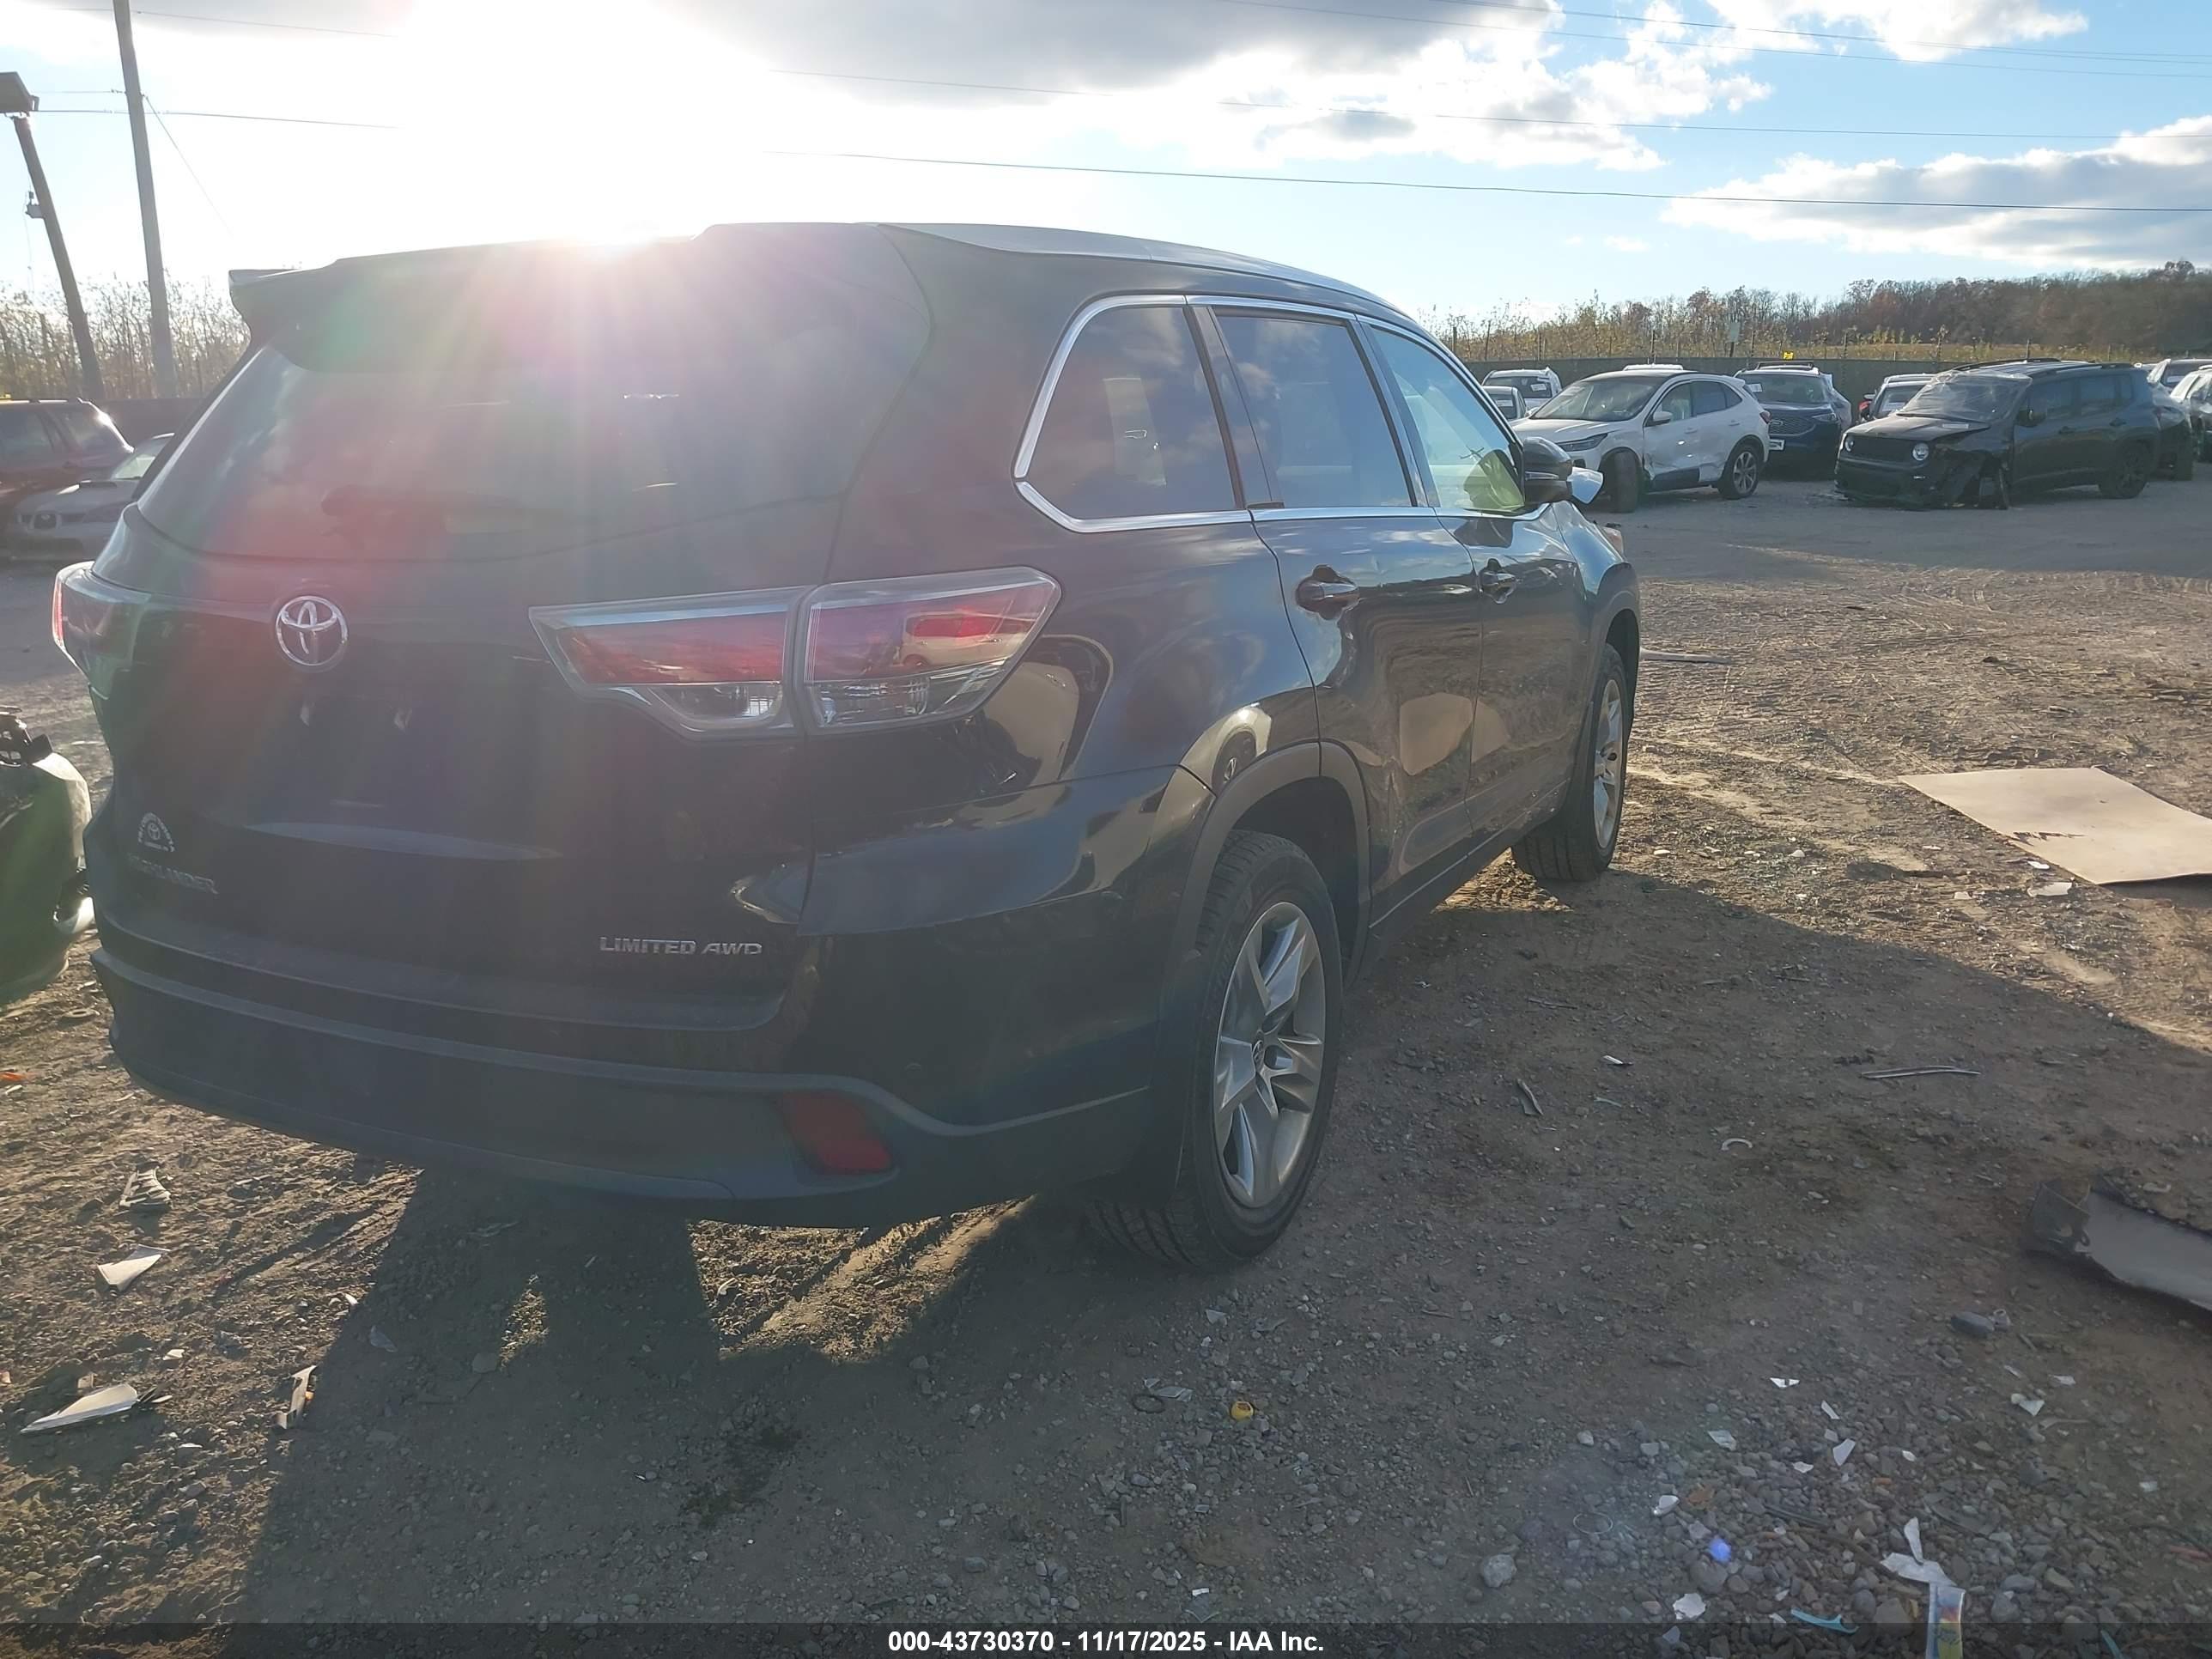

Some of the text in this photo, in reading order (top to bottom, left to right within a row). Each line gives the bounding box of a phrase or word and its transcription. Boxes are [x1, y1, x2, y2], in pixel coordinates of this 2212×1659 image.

[126, 852, 219, 894] GHLANDER
[600, 936, 763, 955] LIMITED AWD
